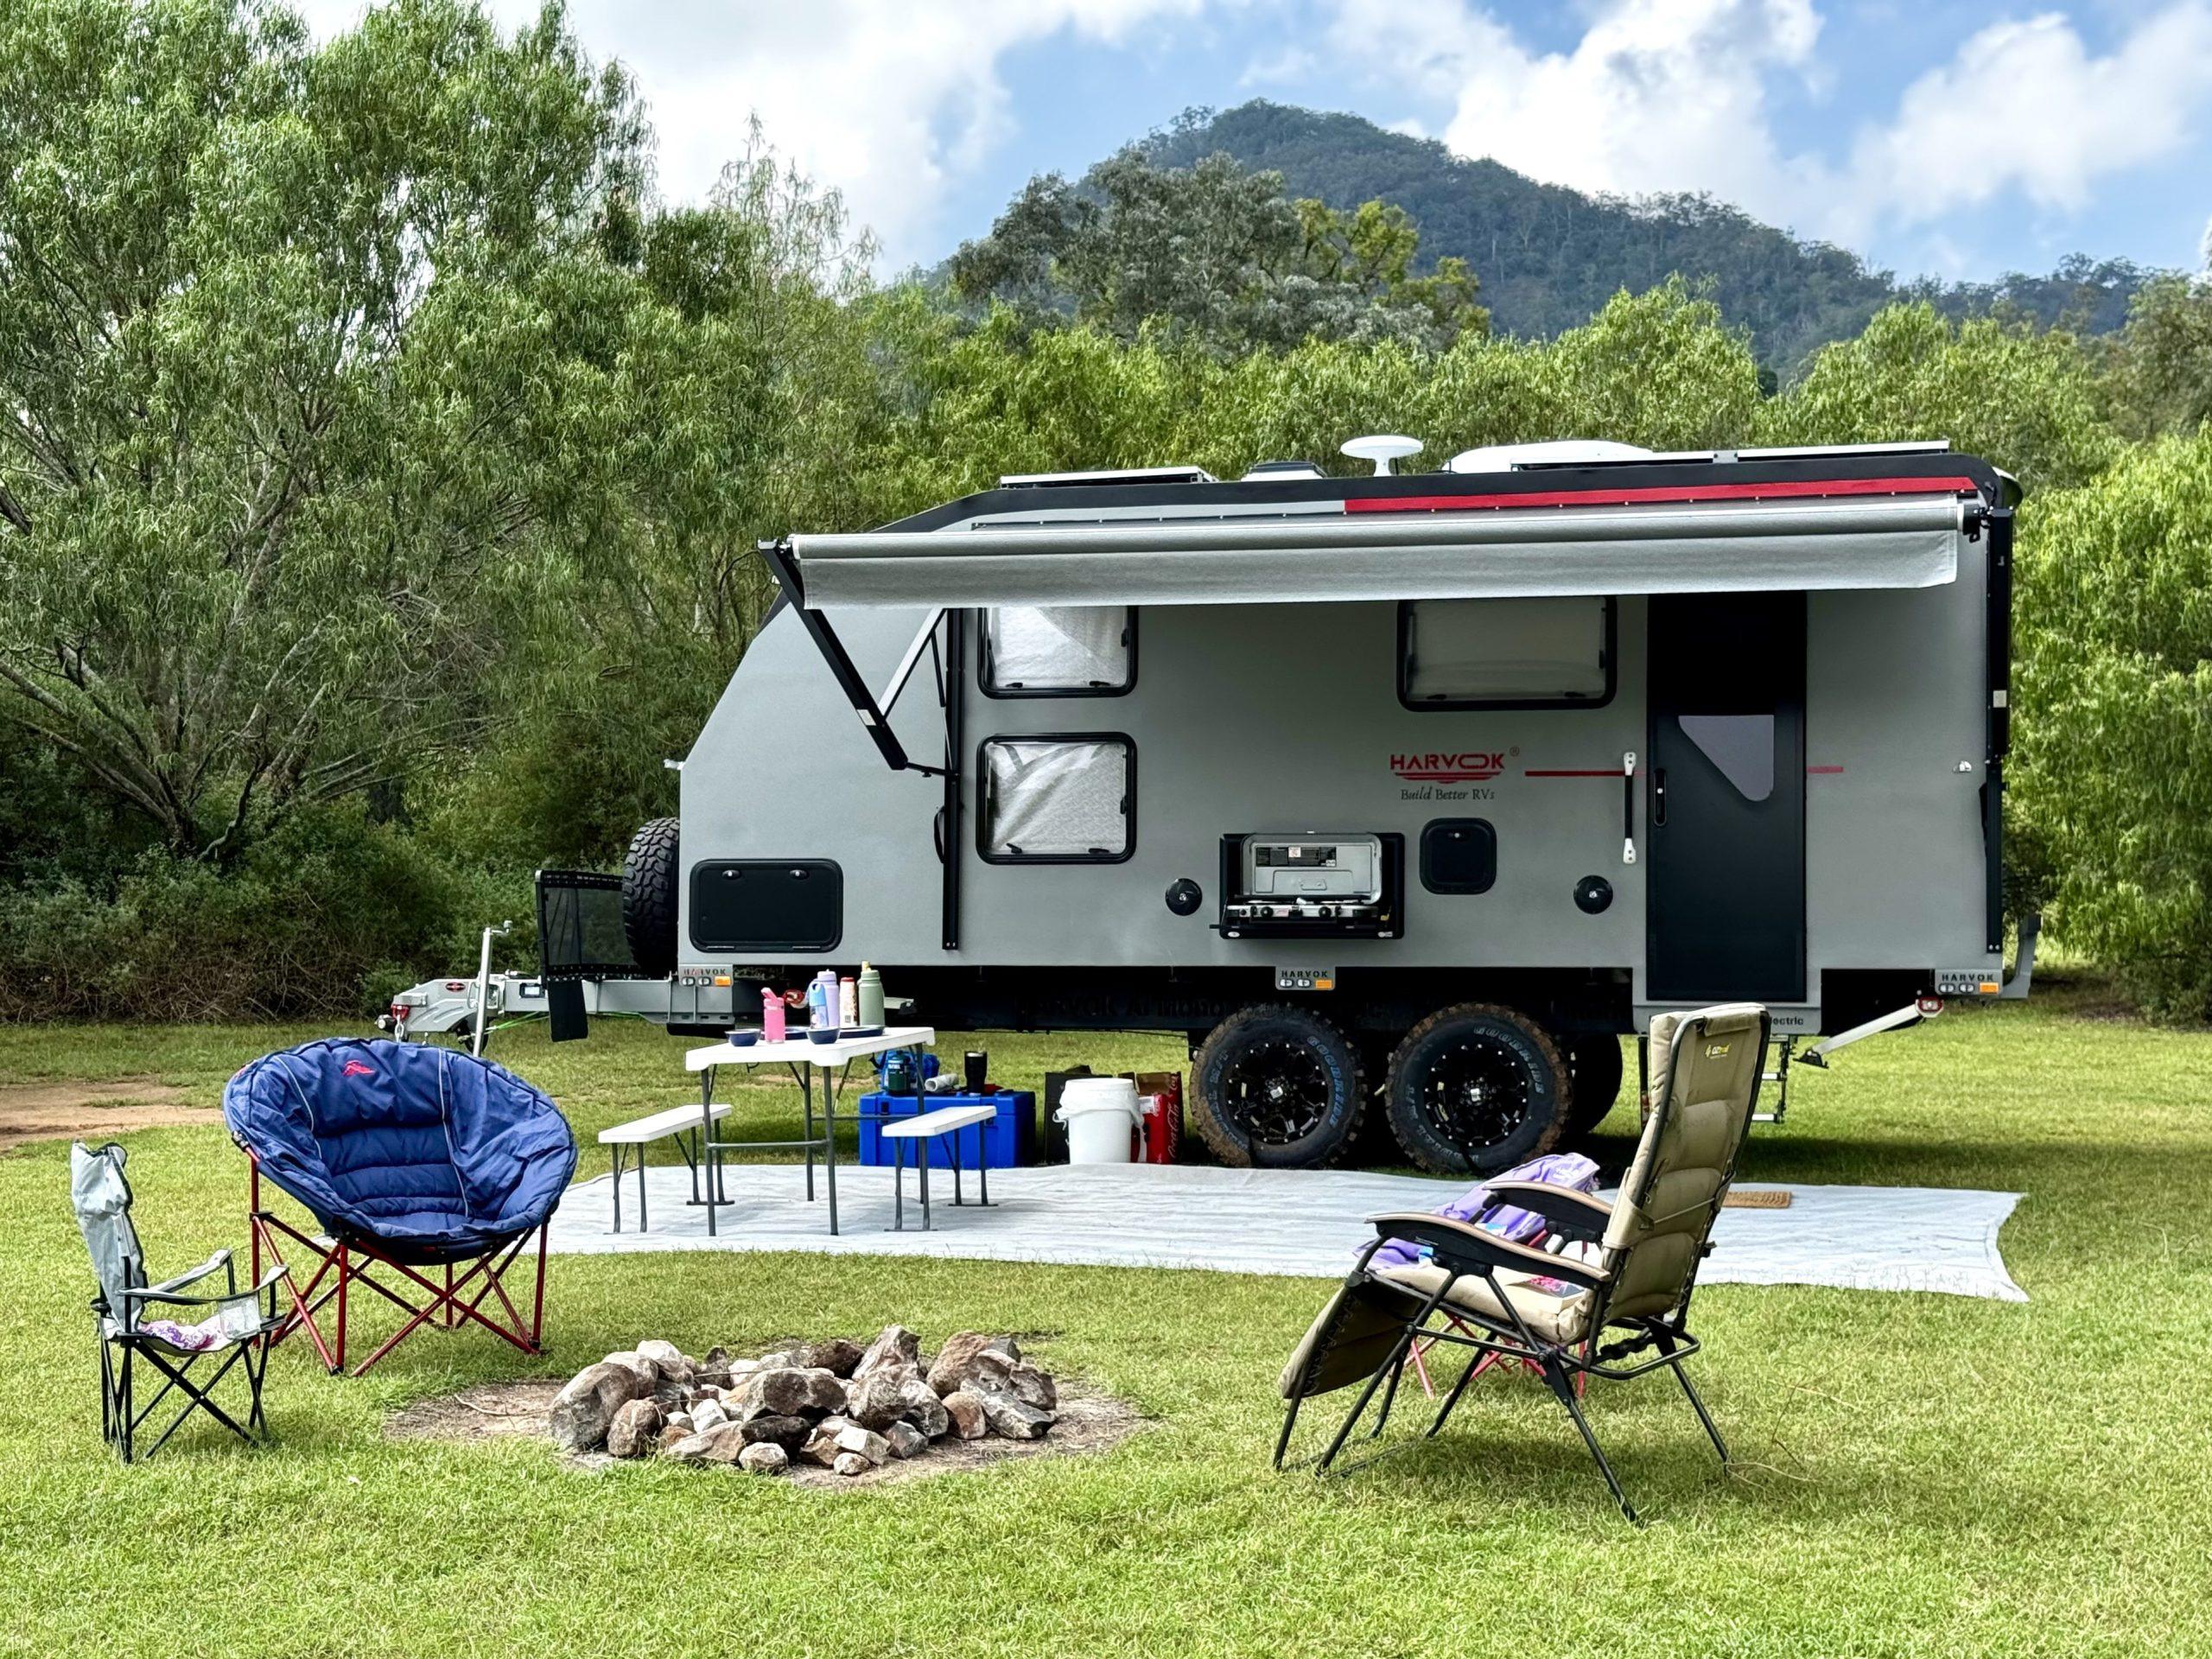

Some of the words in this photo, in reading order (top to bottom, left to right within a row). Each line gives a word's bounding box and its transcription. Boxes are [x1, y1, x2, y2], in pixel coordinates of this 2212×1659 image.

[1389, 753, 1505, 770] HARVOK
[1401, 786, 1432, 800] Build
[1435, 787, 1469, 800] Better
[1471, 788, 1495, 800] RVs
[1942, 973, 1994, 982] HARVOK
[1770, 1015, 1804, 1026] lectric
